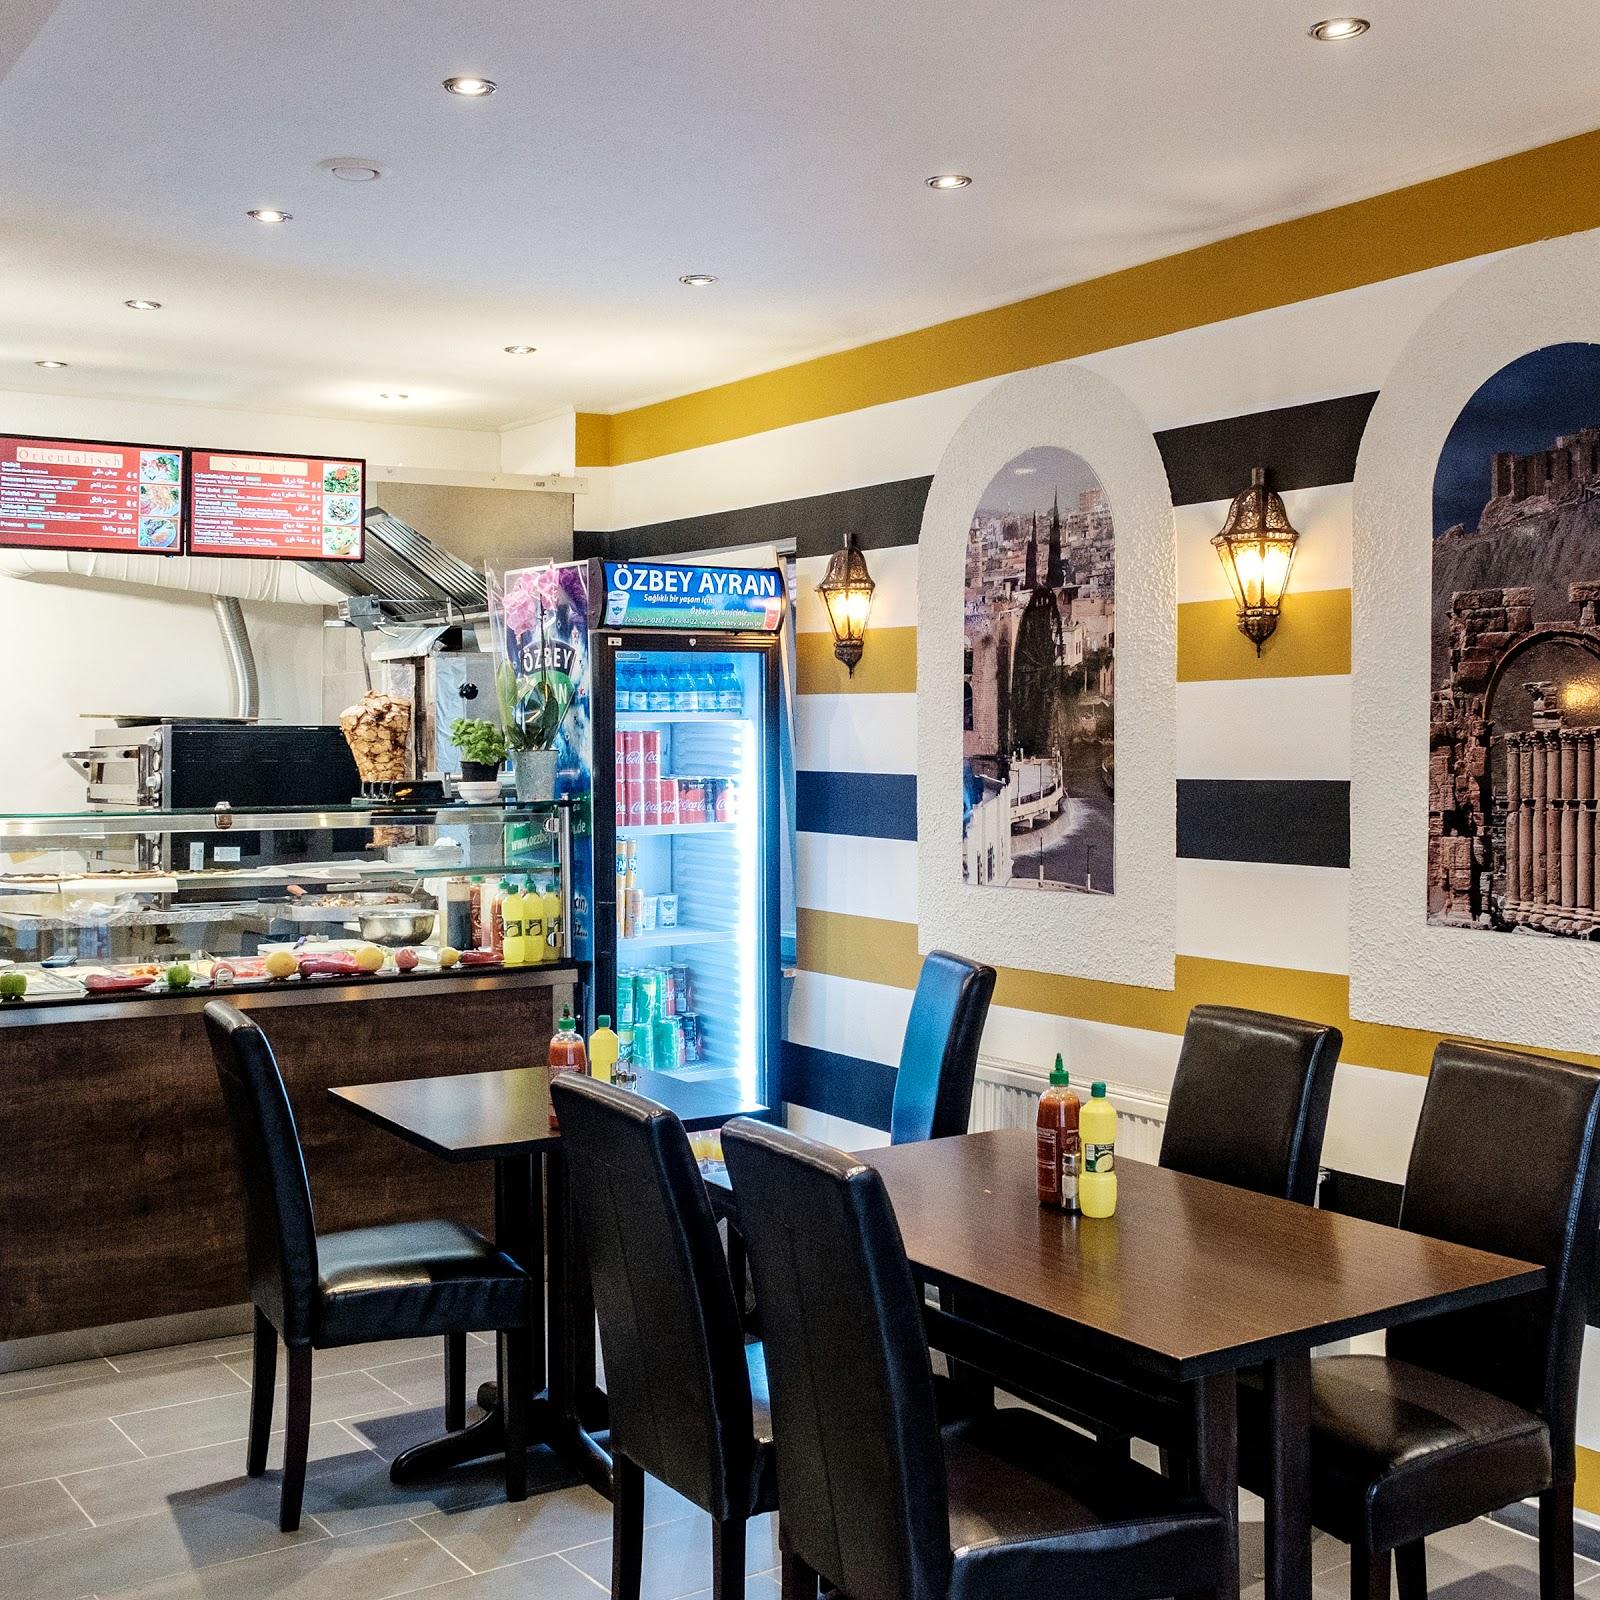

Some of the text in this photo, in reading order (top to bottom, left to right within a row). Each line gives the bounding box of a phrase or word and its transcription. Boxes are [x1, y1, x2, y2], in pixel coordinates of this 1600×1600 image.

[18, 448, 122, 467] Orientalisch
[613, 564, 776, 597] ÖZBEY AYRAN
[669, 594, 679, 602] bir
[690, 605, 710, 616] Özbey
[523, 646, 572, 672] ÖZBEY
